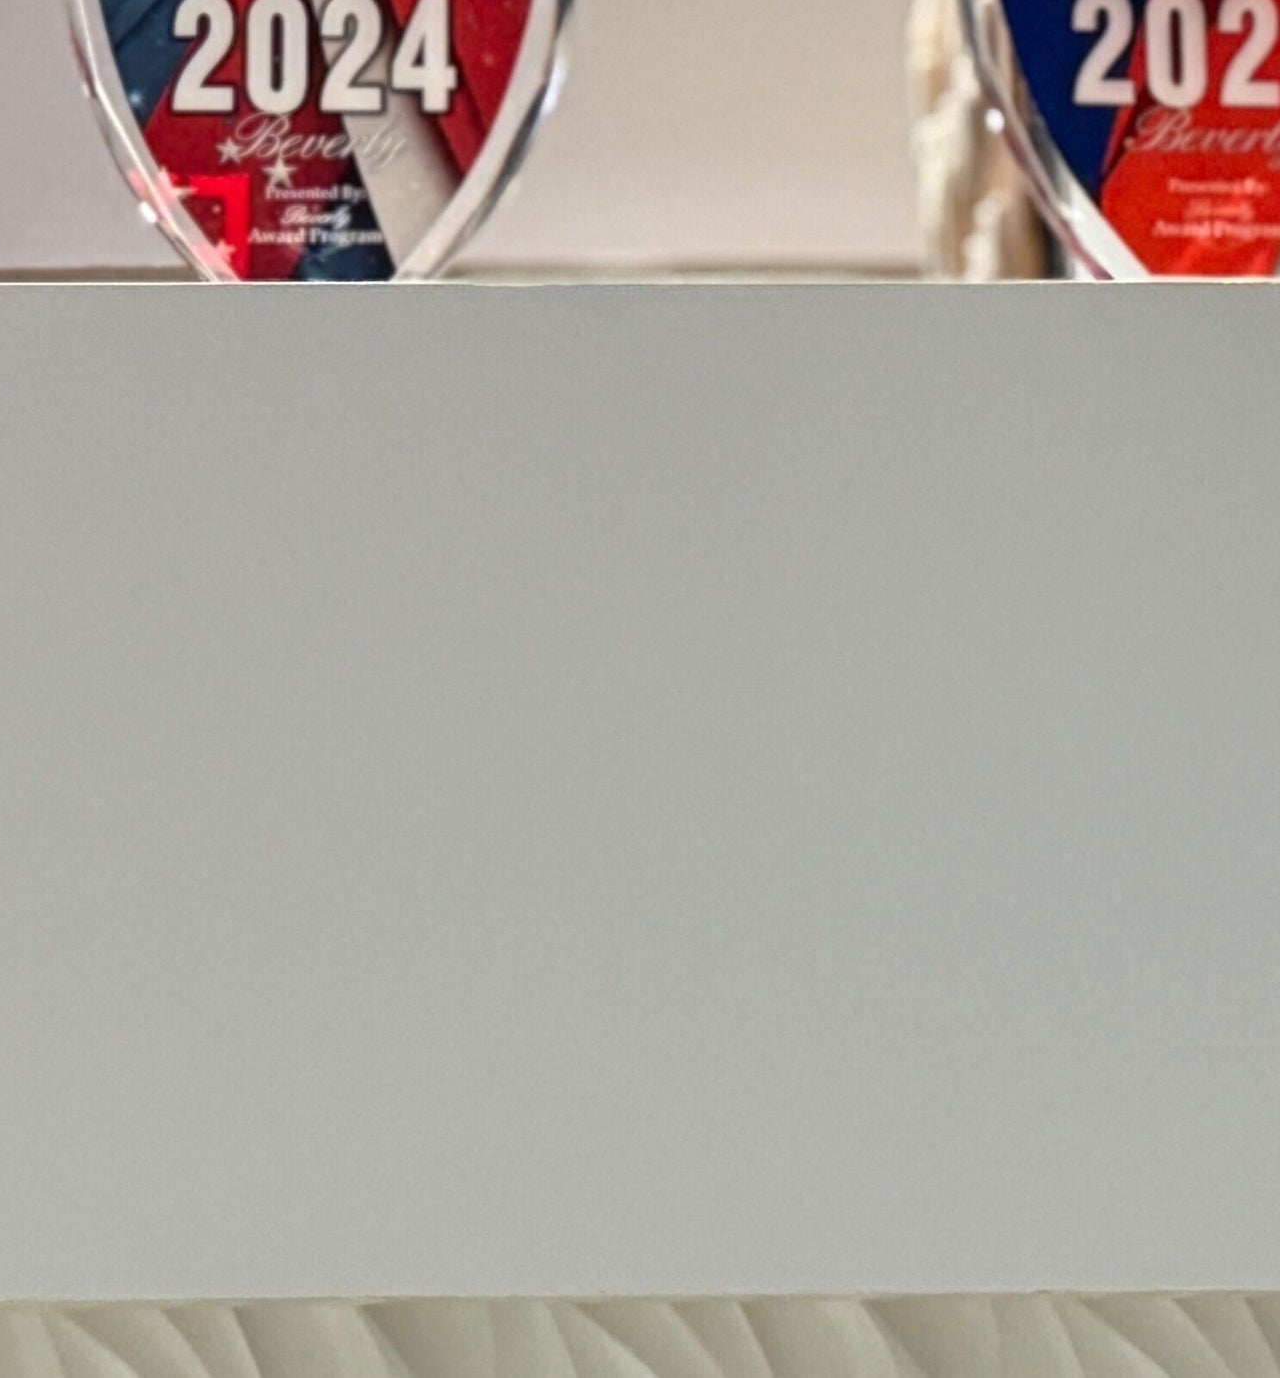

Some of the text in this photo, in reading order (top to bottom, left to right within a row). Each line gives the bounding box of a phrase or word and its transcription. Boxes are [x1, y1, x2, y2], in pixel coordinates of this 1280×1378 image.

[232, 109, 407, 170] Beverly
[265, 186, 338, 201] Presented
[247, 228, 383, 249] Award Program
